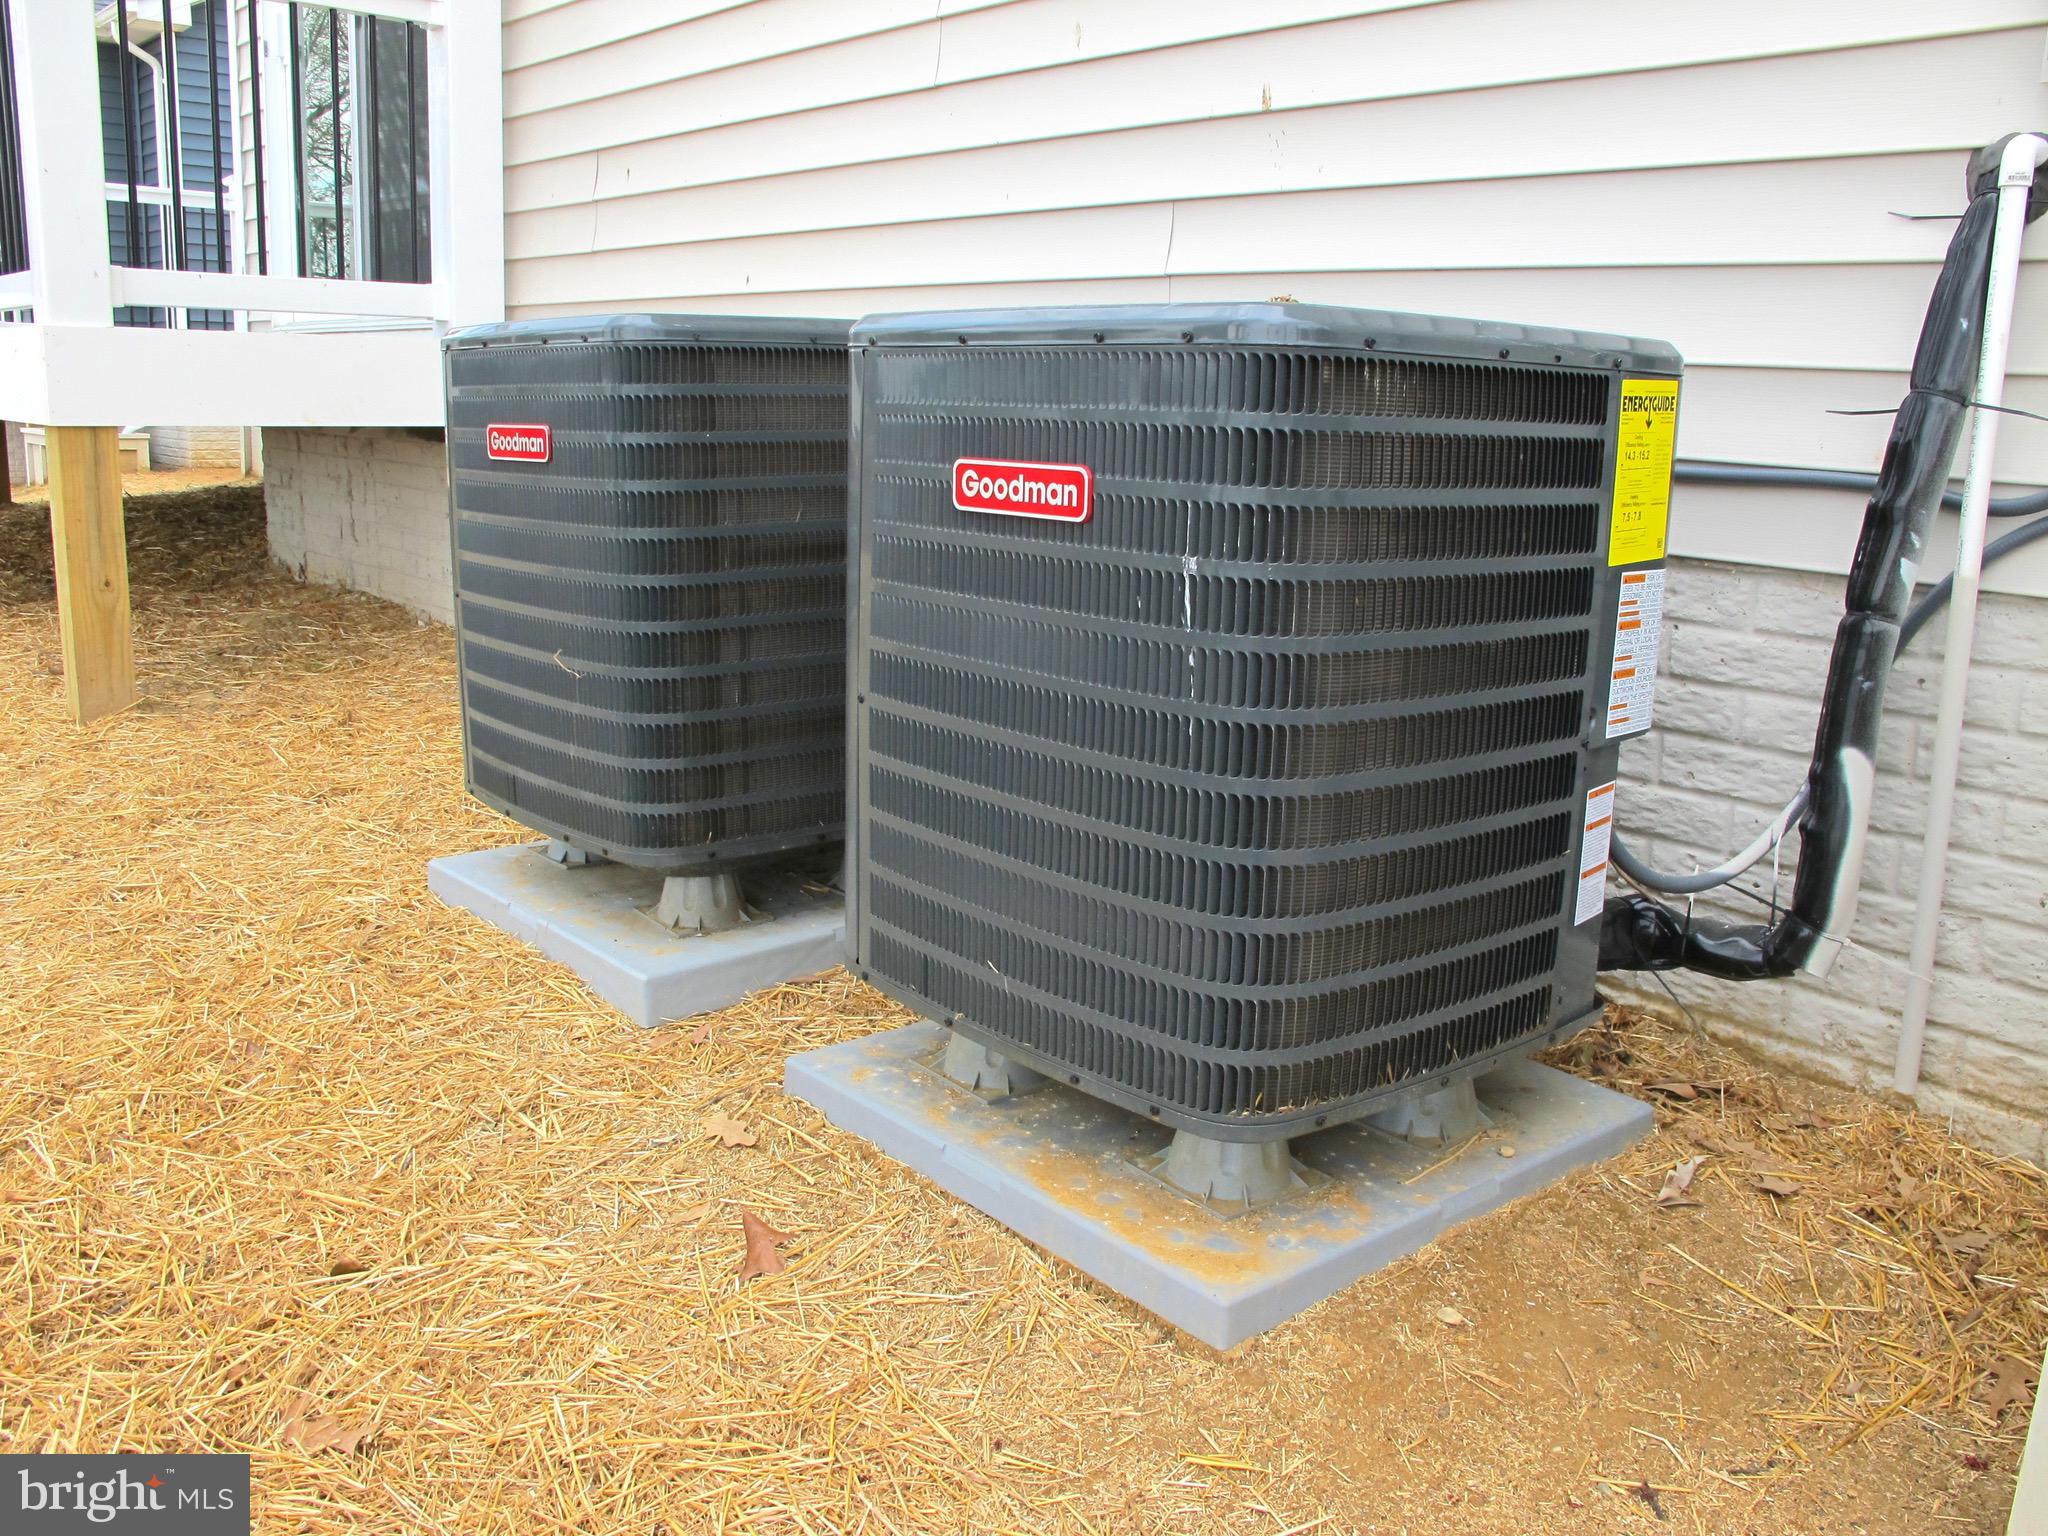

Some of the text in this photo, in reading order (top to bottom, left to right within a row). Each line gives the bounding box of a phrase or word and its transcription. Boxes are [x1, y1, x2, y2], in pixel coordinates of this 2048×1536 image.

[1622, 395, 1676, 413] ENERGYGUIDE
[490, 431, 544, 453] Goodman
[961, 469, 1078, 508] Goodman
